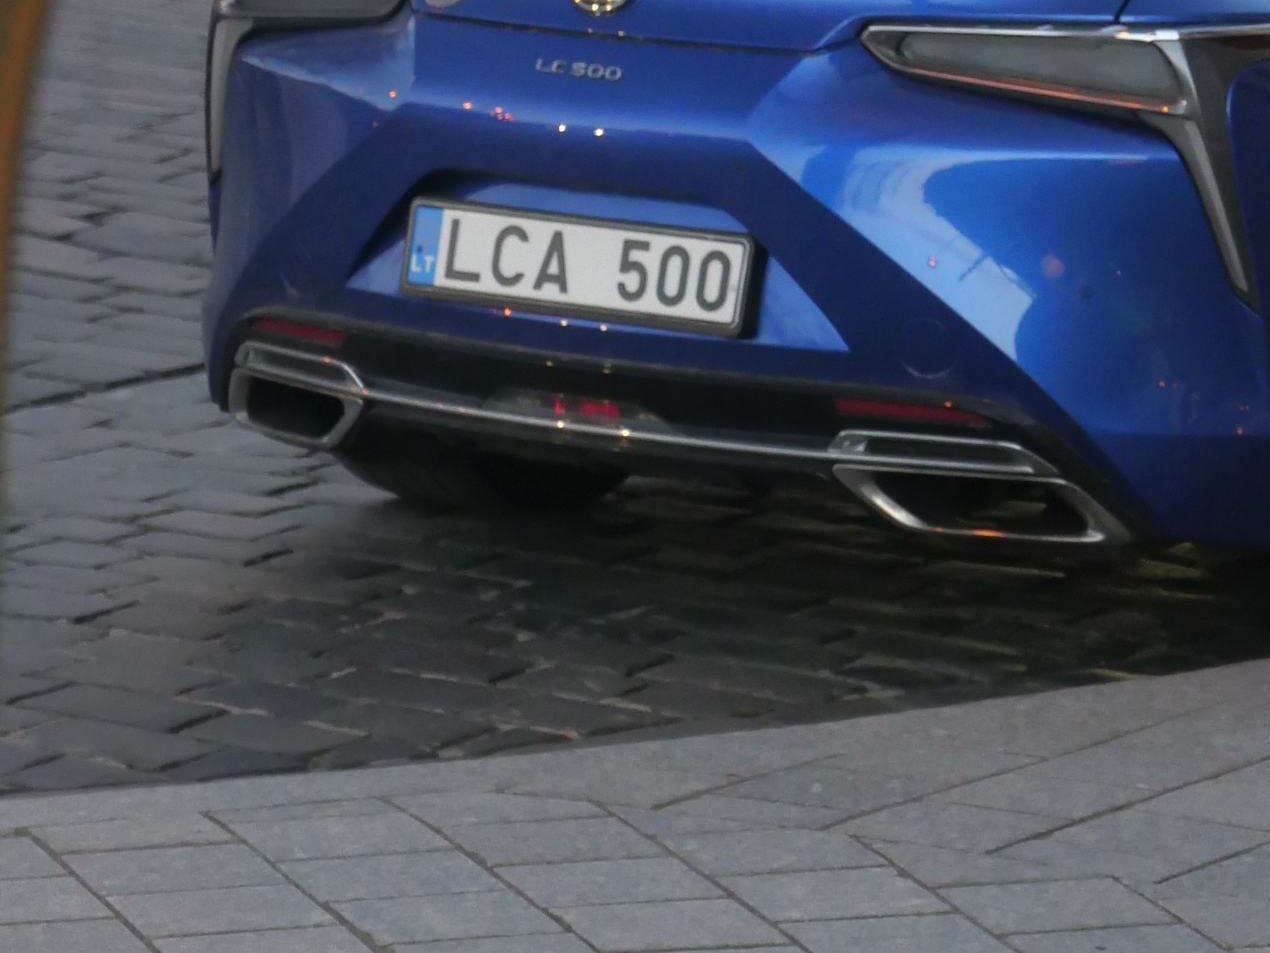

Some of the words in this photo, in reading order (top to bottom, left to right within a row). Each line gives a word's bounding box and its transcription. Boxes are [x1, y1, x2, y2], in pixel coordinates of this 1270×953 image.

[535, 57, 567, 75] LC
[571, 61, 622, 82] 500
[410, 254, 435, 273] LT
[444, 217, 569, 295] LCA
[616, 238, 732, 312] 500
